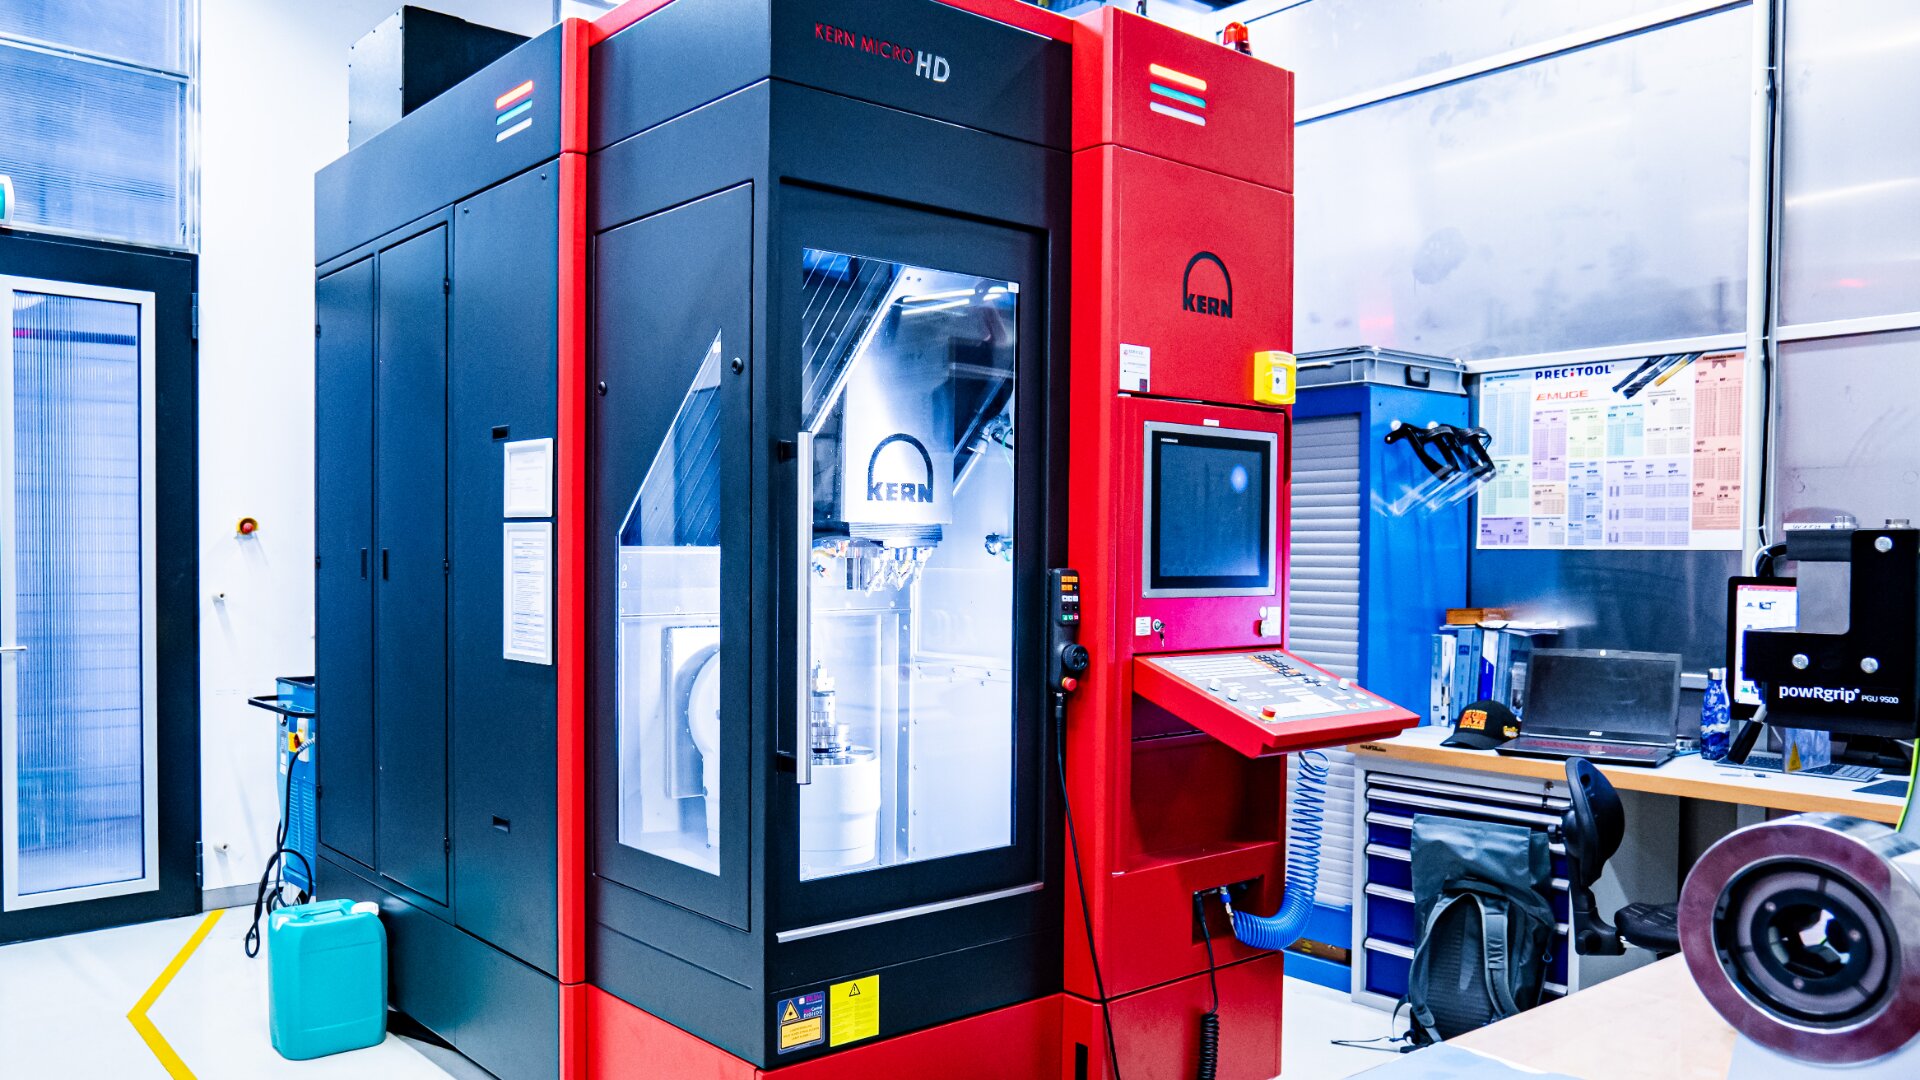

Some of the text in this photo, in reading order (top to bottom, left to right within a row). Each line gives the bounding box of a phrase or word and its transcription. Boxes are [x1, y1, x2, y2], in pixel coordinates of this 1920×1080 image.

[815, 22, 951, 83] KERN MICRO HD
[1183, 293, 1233, 319] KERN
[1536, 389, 1589, 401] EMUGE
[867, 481, 934, 503] KERN
[1861, 694, 1878, 703] PGU
[1879, 695, 1899, 704] 9500
